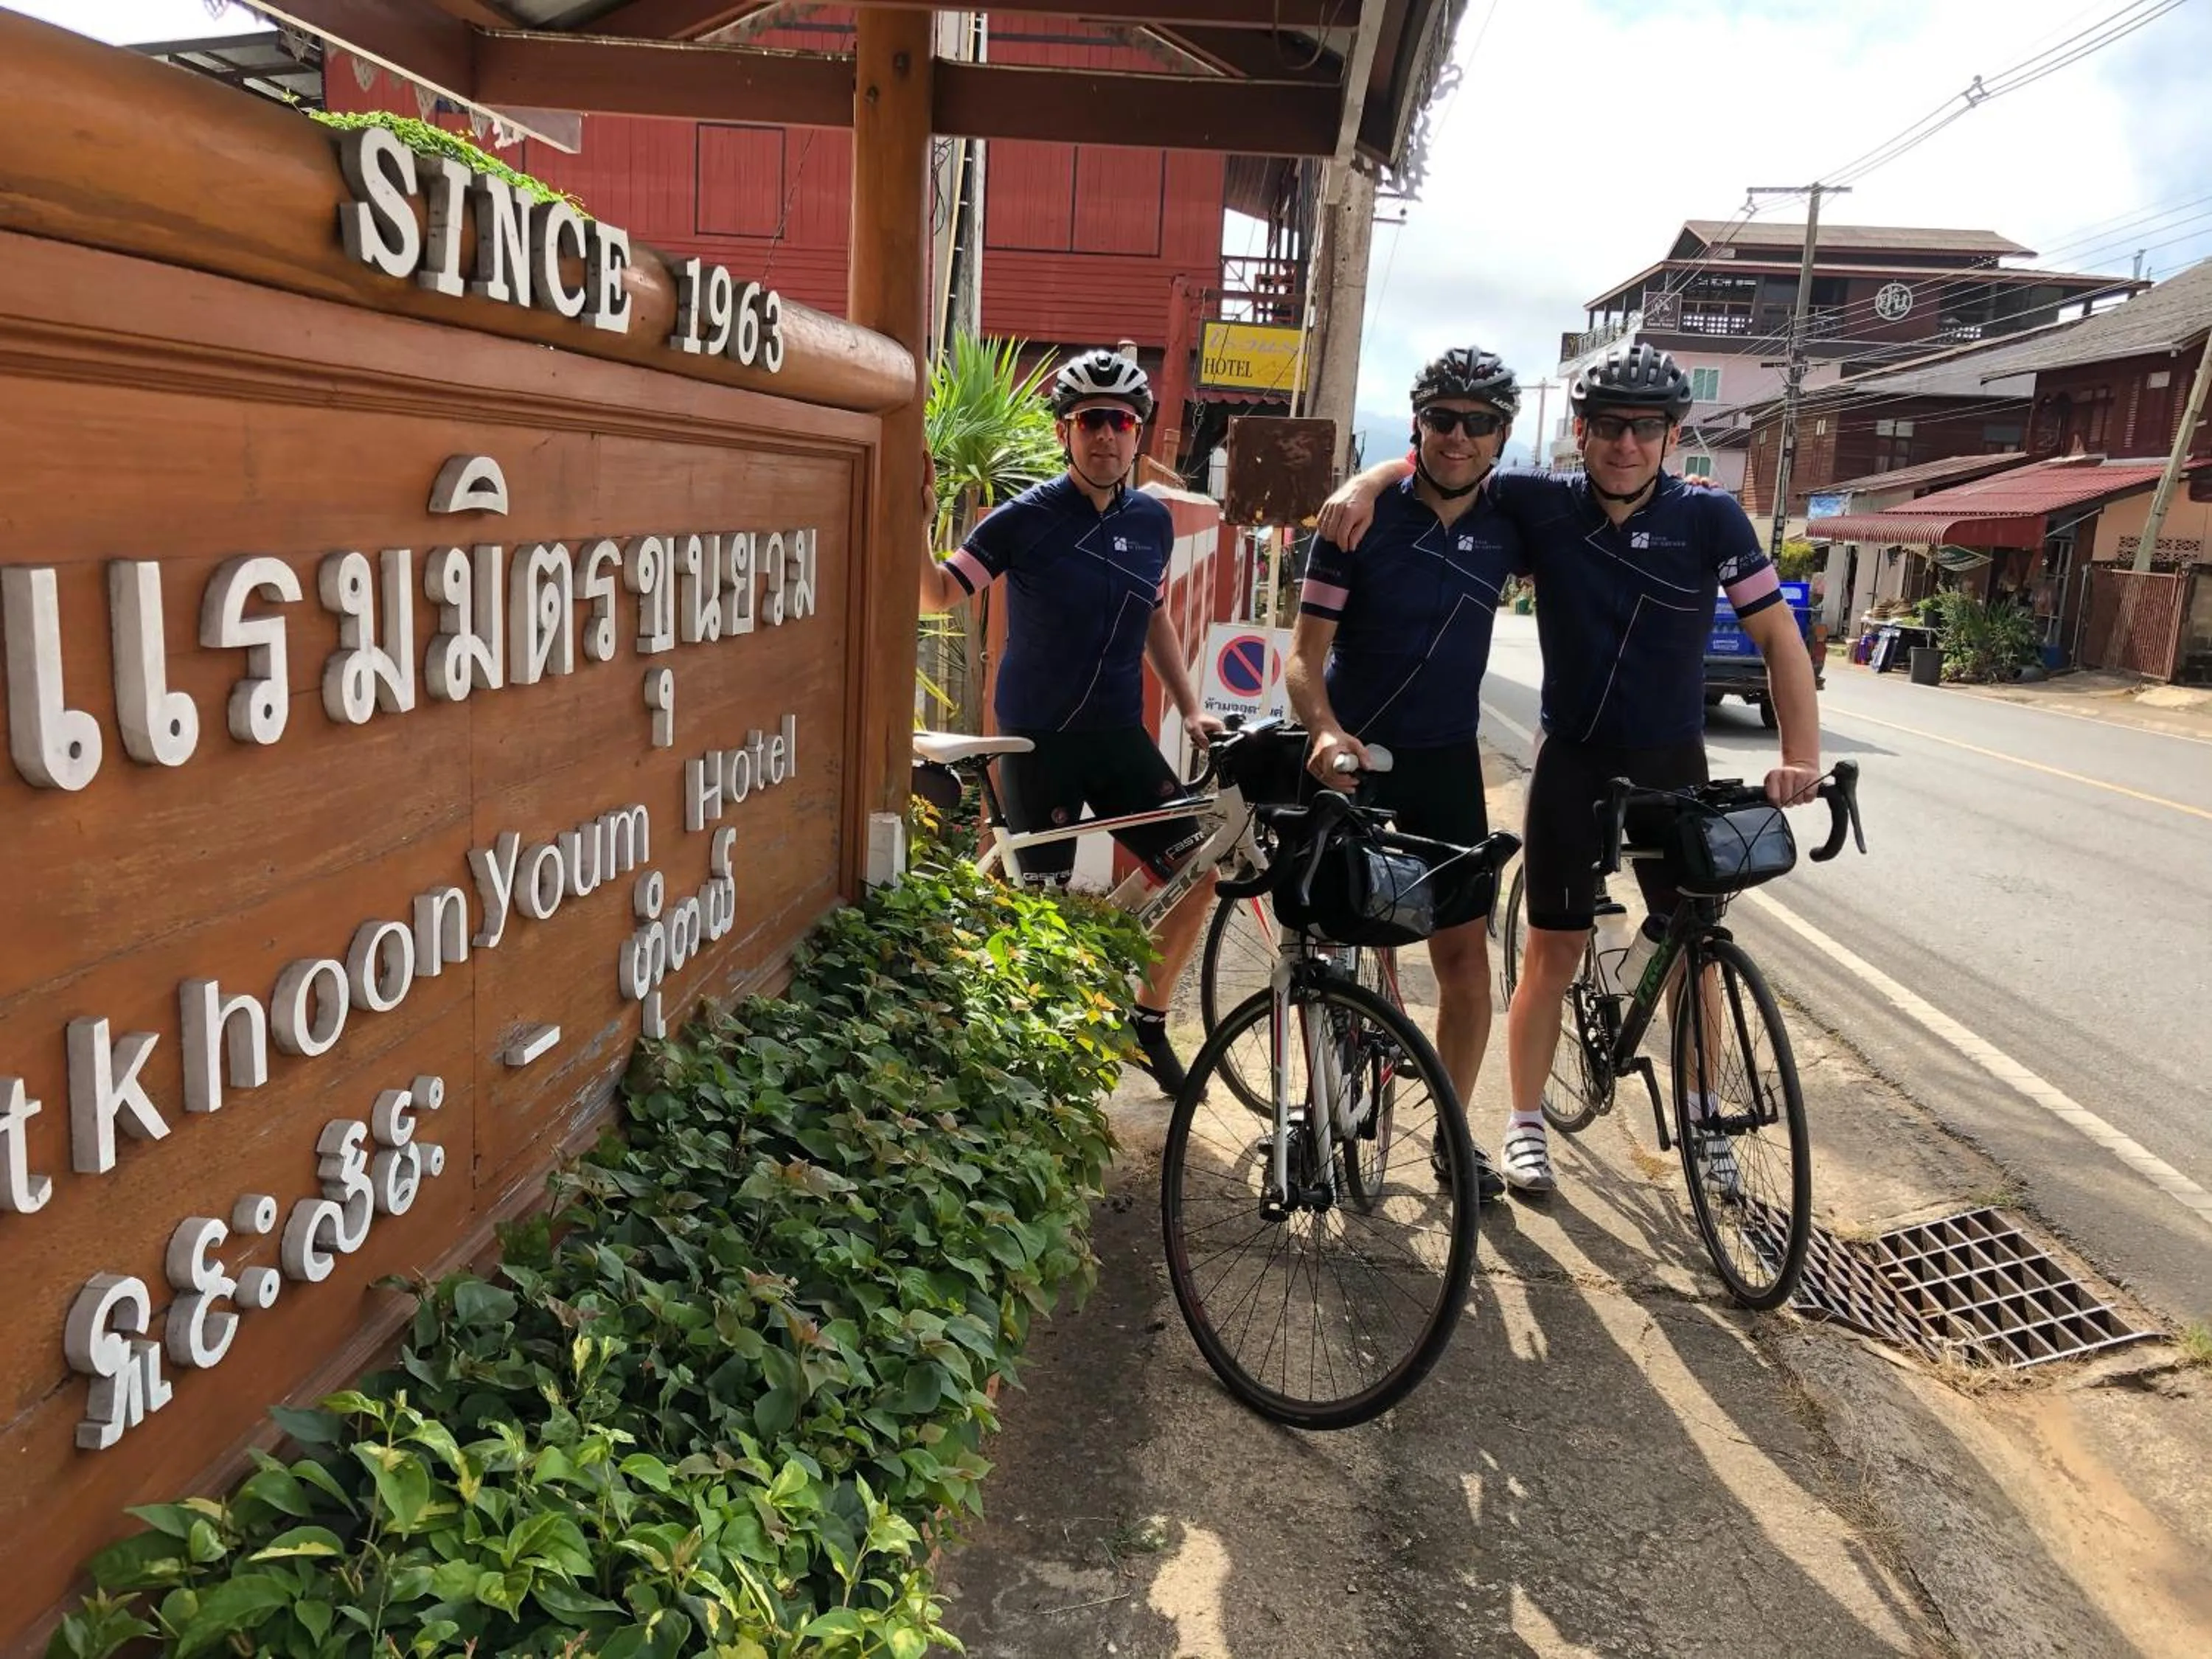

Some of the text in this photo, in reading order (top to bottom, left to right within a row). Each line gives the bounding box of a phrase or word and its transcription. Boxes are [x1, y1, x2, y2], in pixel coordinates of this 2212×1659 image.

[339, 127, 784, 372] SINCE 1963
[1203, 358, 1253, 378] HOTEL
[1, 455, 817, 792] แรมมิตรขุนยวม
[0, 714, 796, 1214] tkhoonyoum Hotel
[1141, 860, 1206, 932] REK
